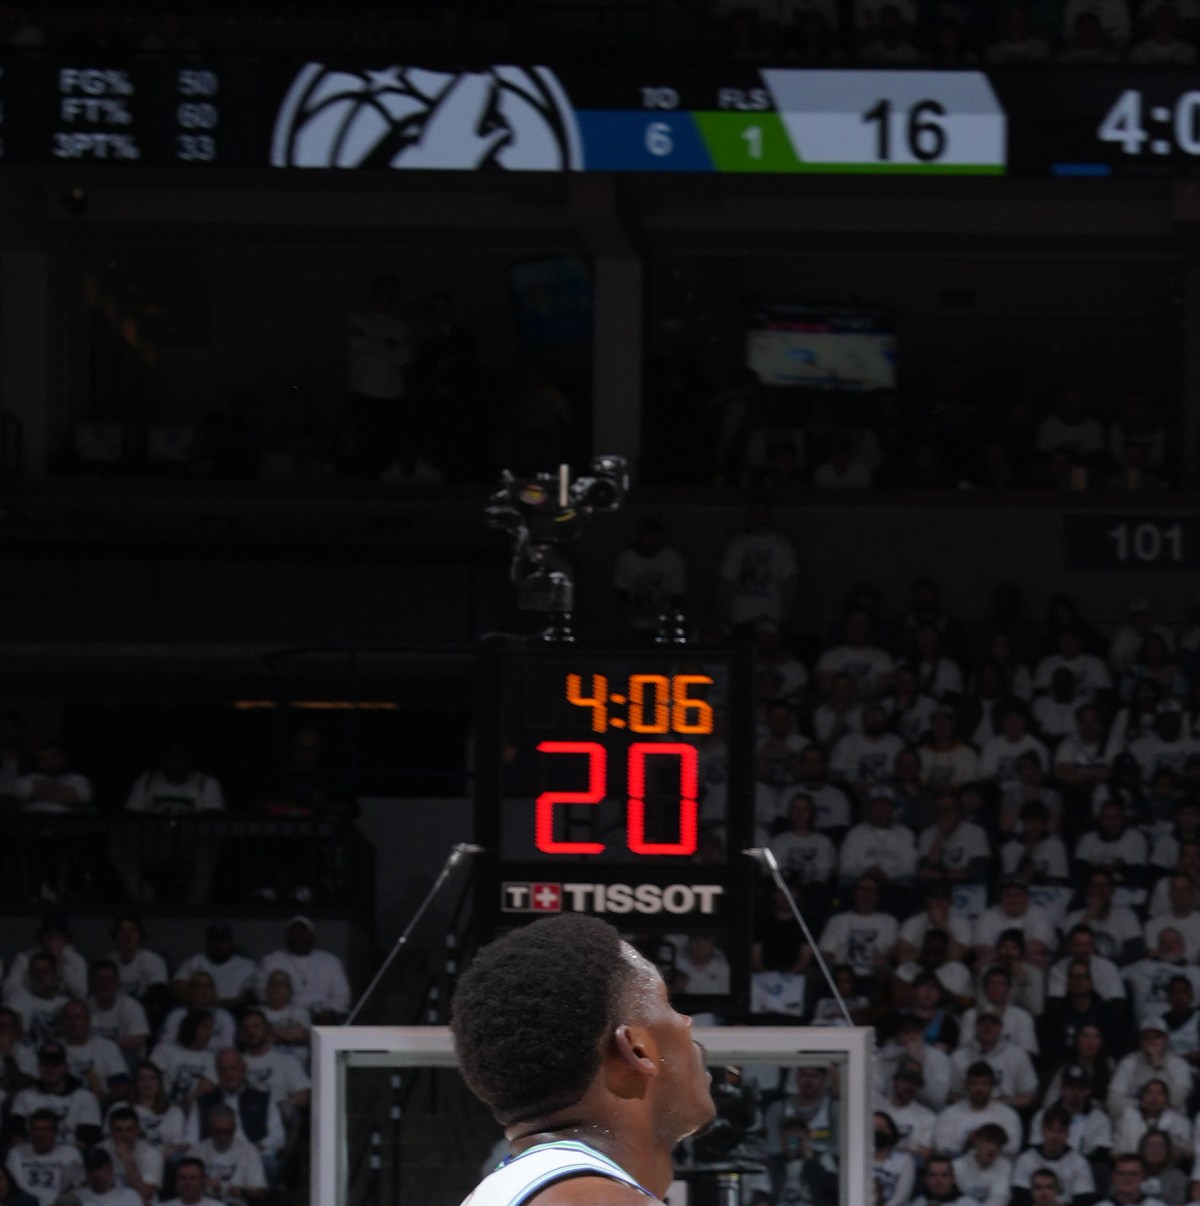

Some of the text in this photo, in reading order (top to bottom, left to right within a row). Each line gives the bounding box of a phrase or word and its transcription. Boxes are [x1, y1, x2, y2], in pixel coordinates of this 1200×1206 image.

[58, 67, 135, 96] FG%
[637, 87, 768, 110] TO FLS
[59, 97, 133, 126] FT%
[51, 130, 141, 160] 3PT%
[644, 121, 675, 157] 6
[740, 124, 764, 160] 1
[861, 98, 949, 162] 16
[1108, 522, 1184, 562] 101
[564, 672, 714, 734] 4:06
[534, 740, 699, 857] 20
[563, 883, 724, 914] TISSOT
